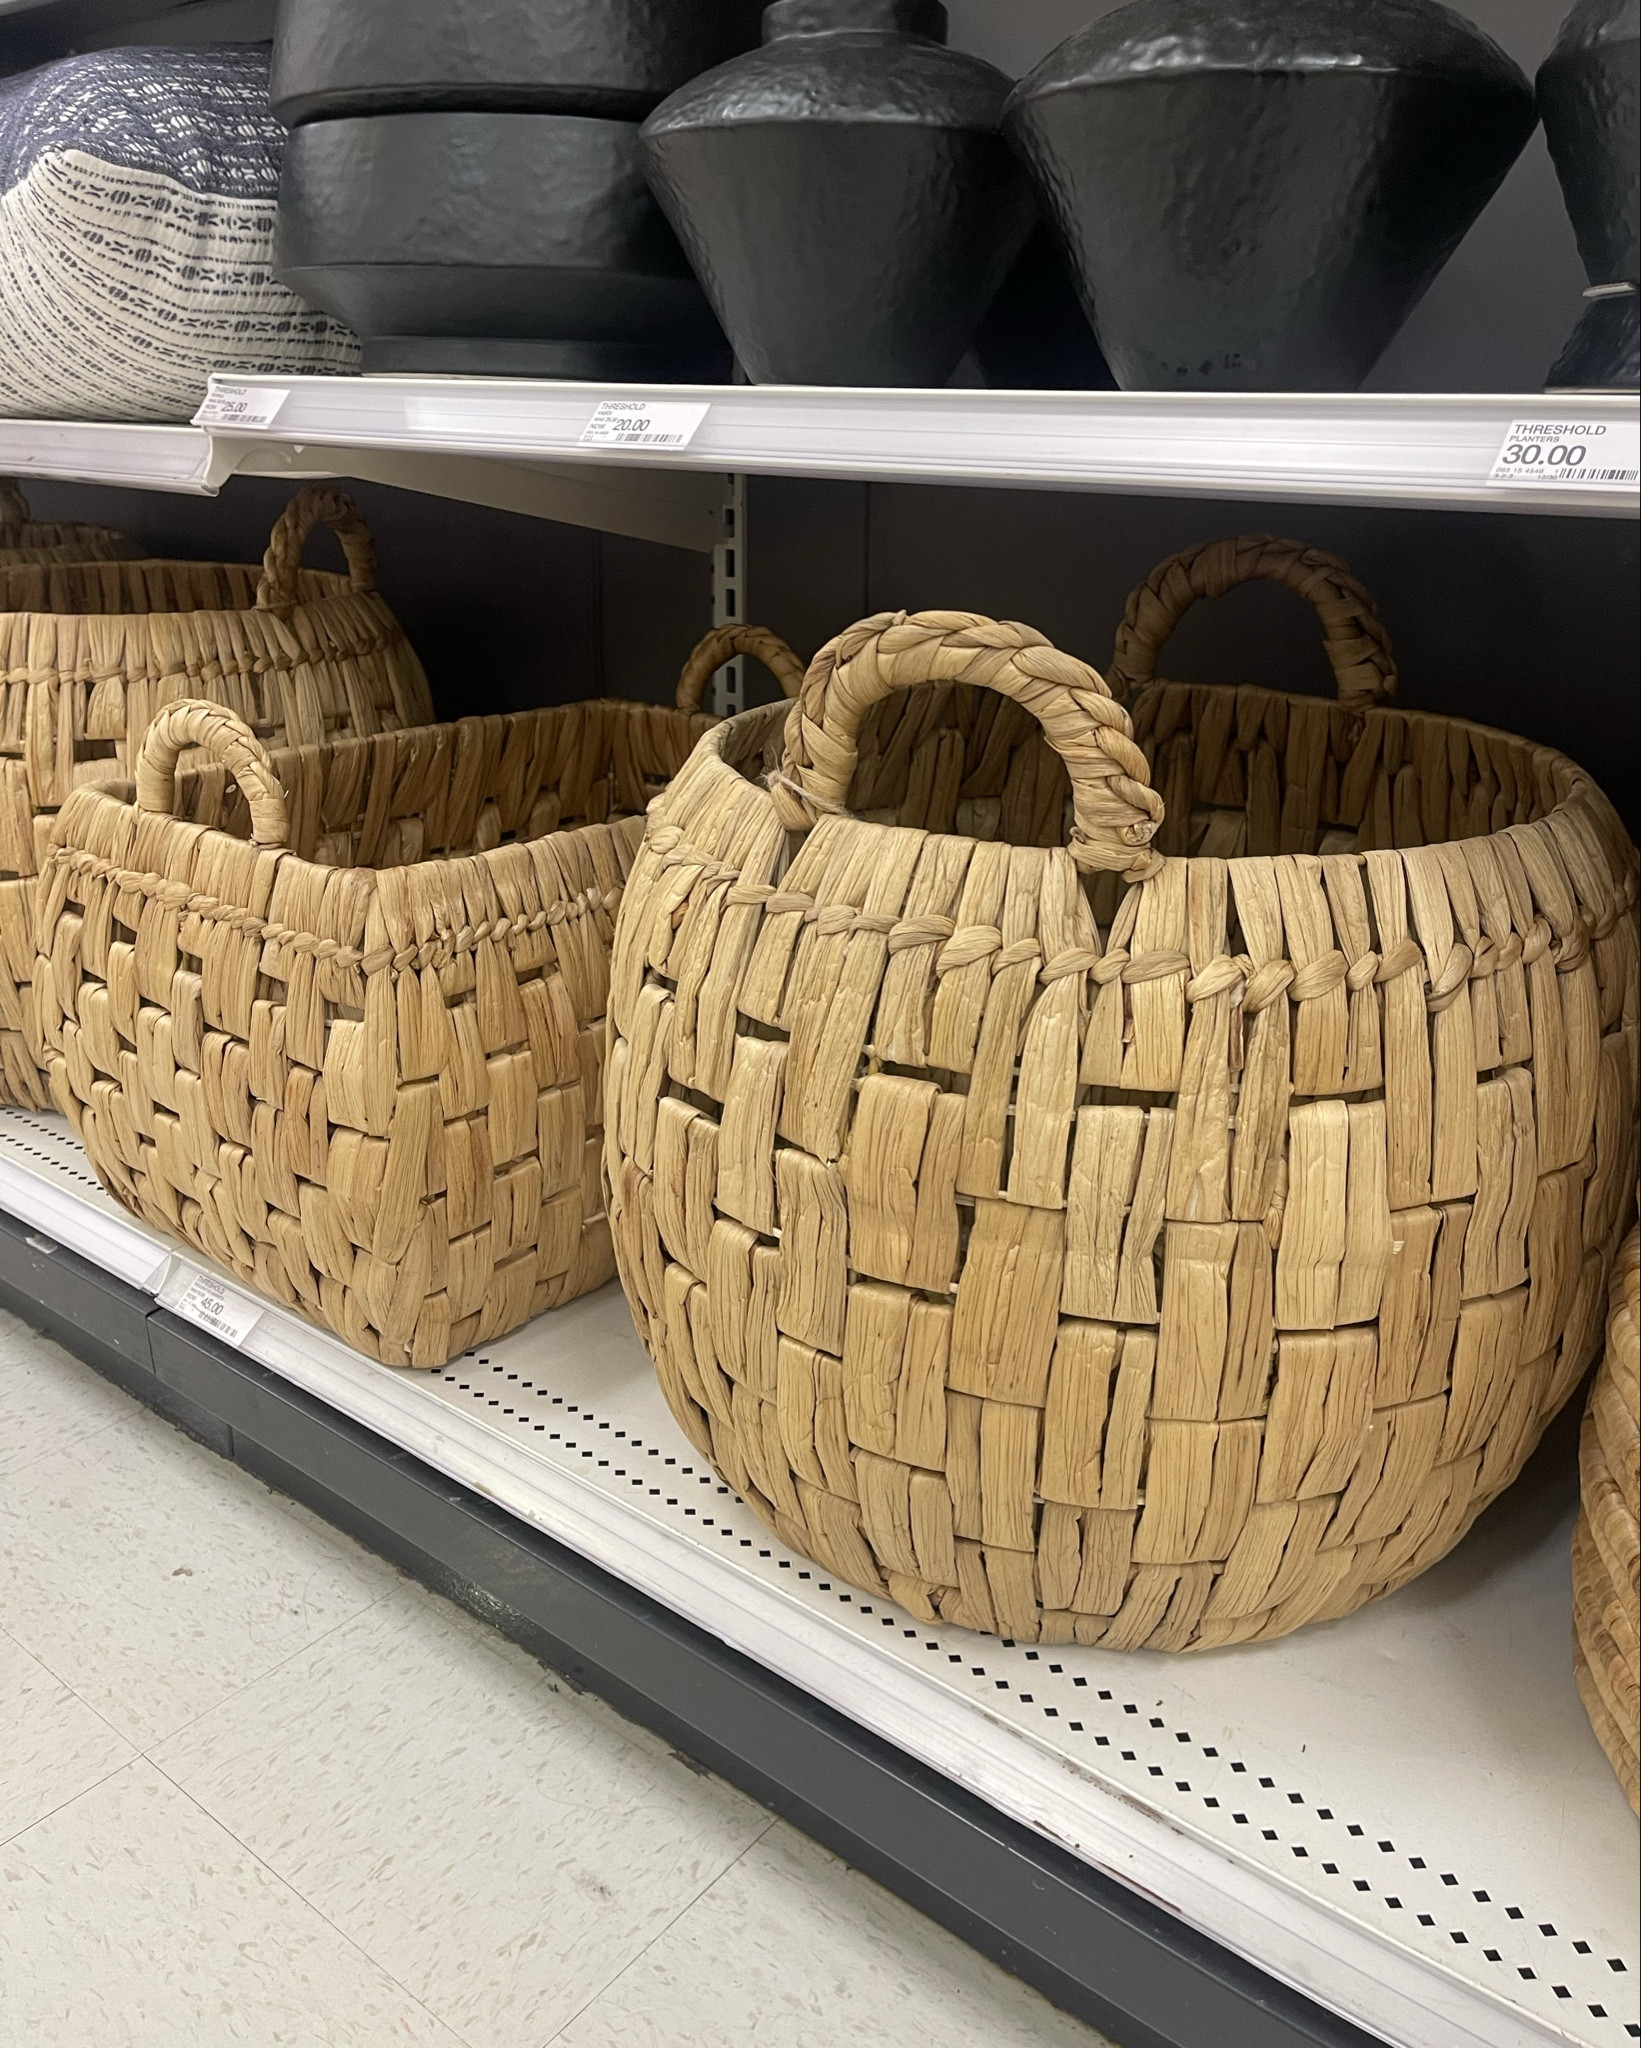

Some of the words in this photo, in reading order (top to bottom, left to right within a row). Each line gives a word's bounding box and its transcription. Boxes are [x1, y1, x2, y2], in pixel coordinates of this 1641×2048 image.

[221, 401, 248, 413] 25.00
[601, 402, 646, 410] THRESHOLD
[612, 419, 650, 431] 20.00
[1515, 424, 1606, 435] THRESHOLD
[1509, 435, 1560, 443] PLANTERS
[1502, 444, 1586, 466] 30.00
[200, 1296, 224, 1316] 45.00
